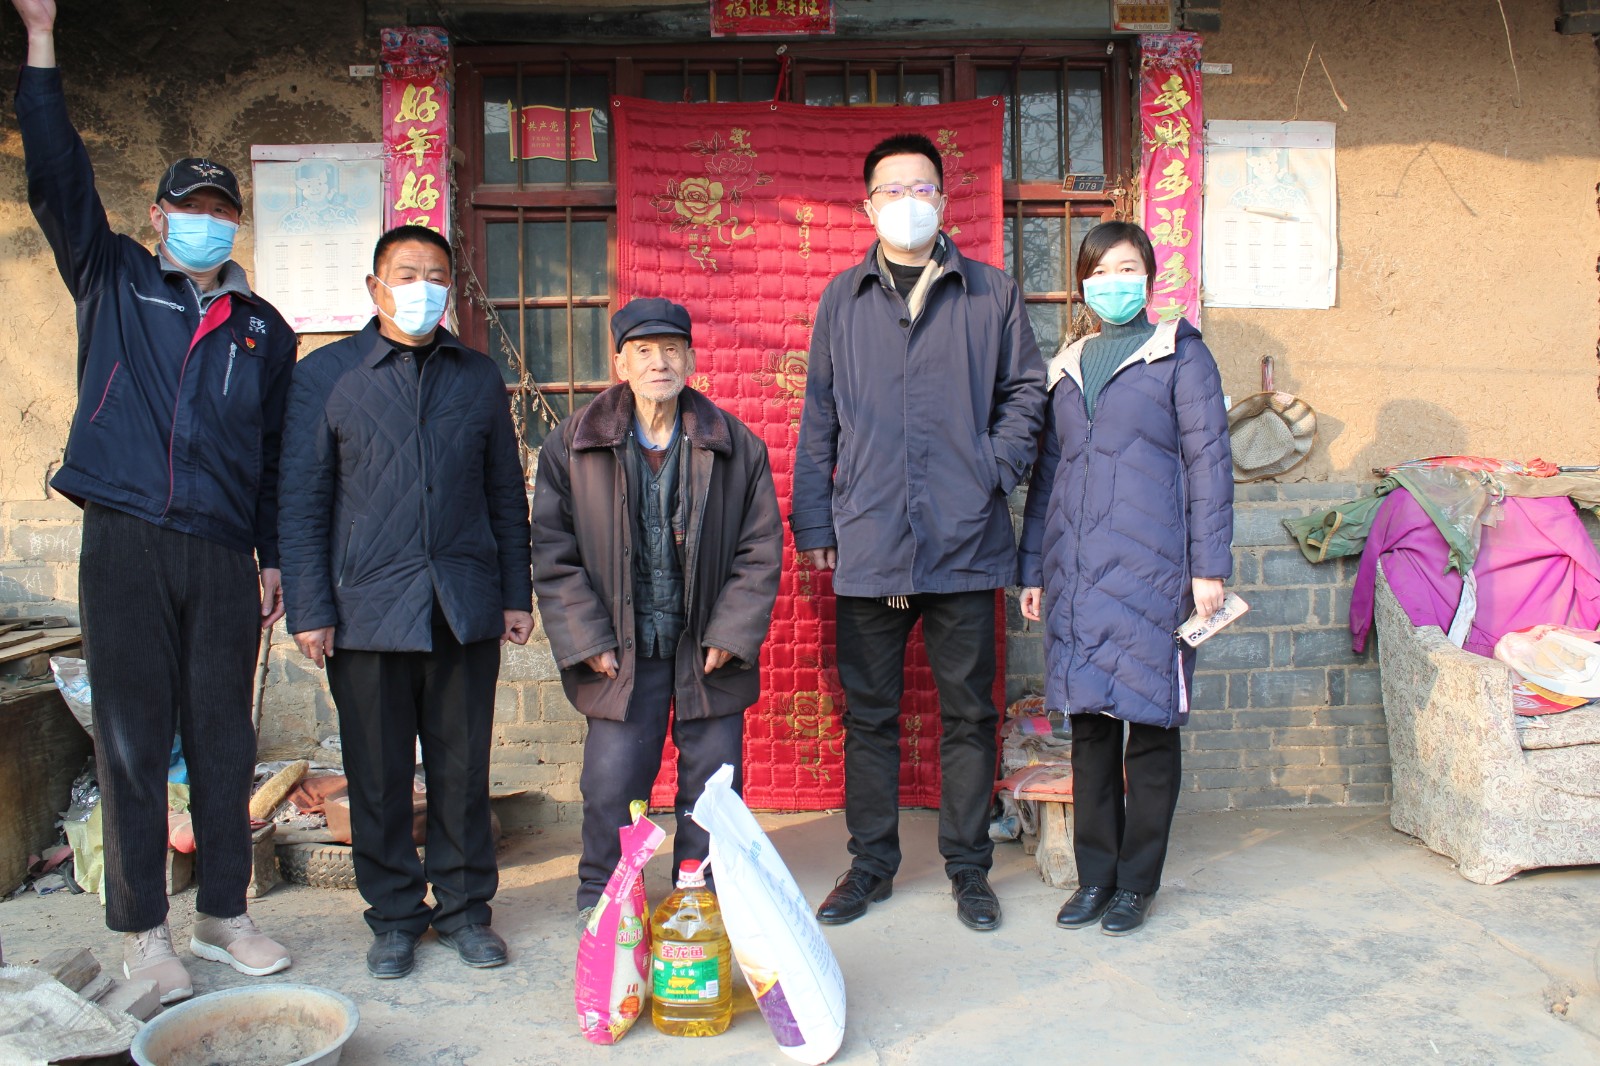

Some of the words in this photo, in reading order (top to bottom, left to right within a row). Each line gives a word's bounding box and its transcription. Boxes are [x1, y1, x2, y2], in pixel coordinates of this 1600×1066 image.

[795, 206, 814, 259] 好日子
[618, 930, 642, 943] 新米
[662, 945, 703, 960] 金龙鱼
